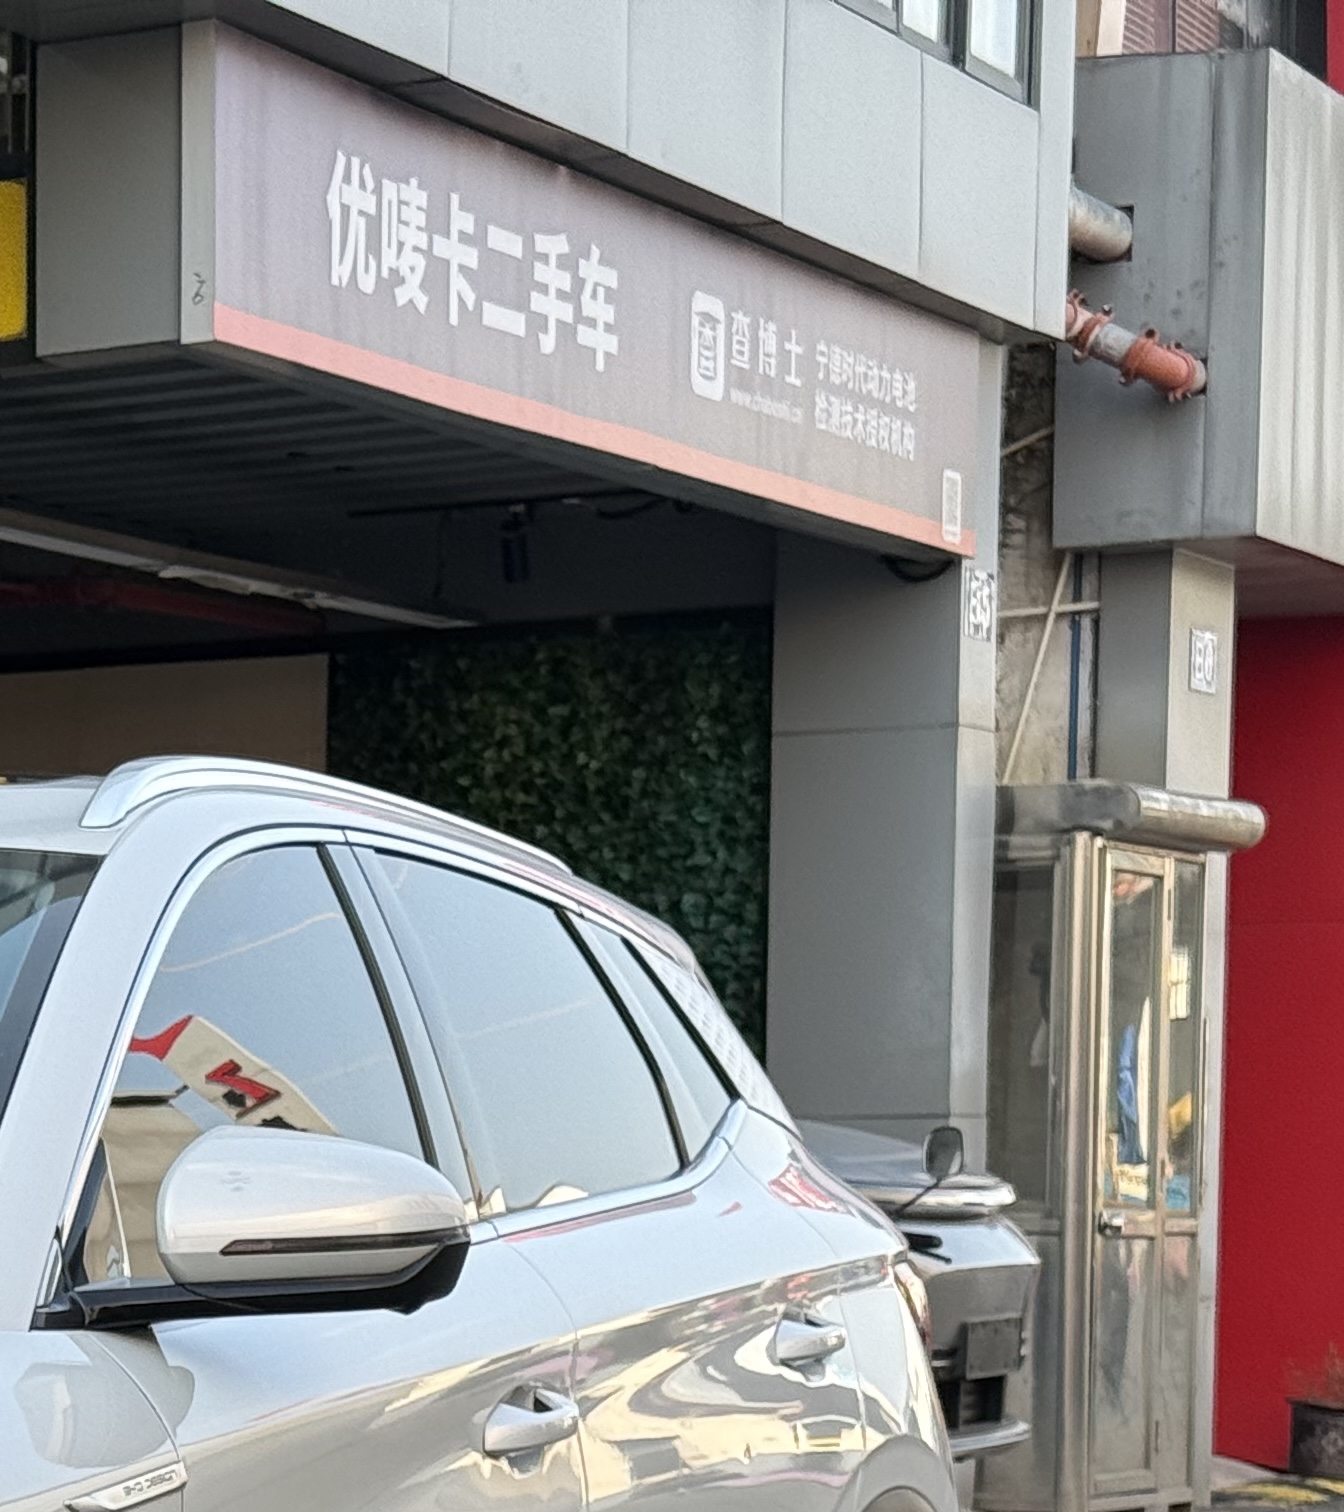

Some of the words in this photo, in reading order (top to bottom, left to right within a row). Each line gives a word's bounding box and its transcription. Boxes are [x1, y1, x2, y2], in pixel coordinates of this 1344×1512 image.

[326, 150, 619, 373] 优唛卡二手车
[730, 310, 803, 388] 查博士
